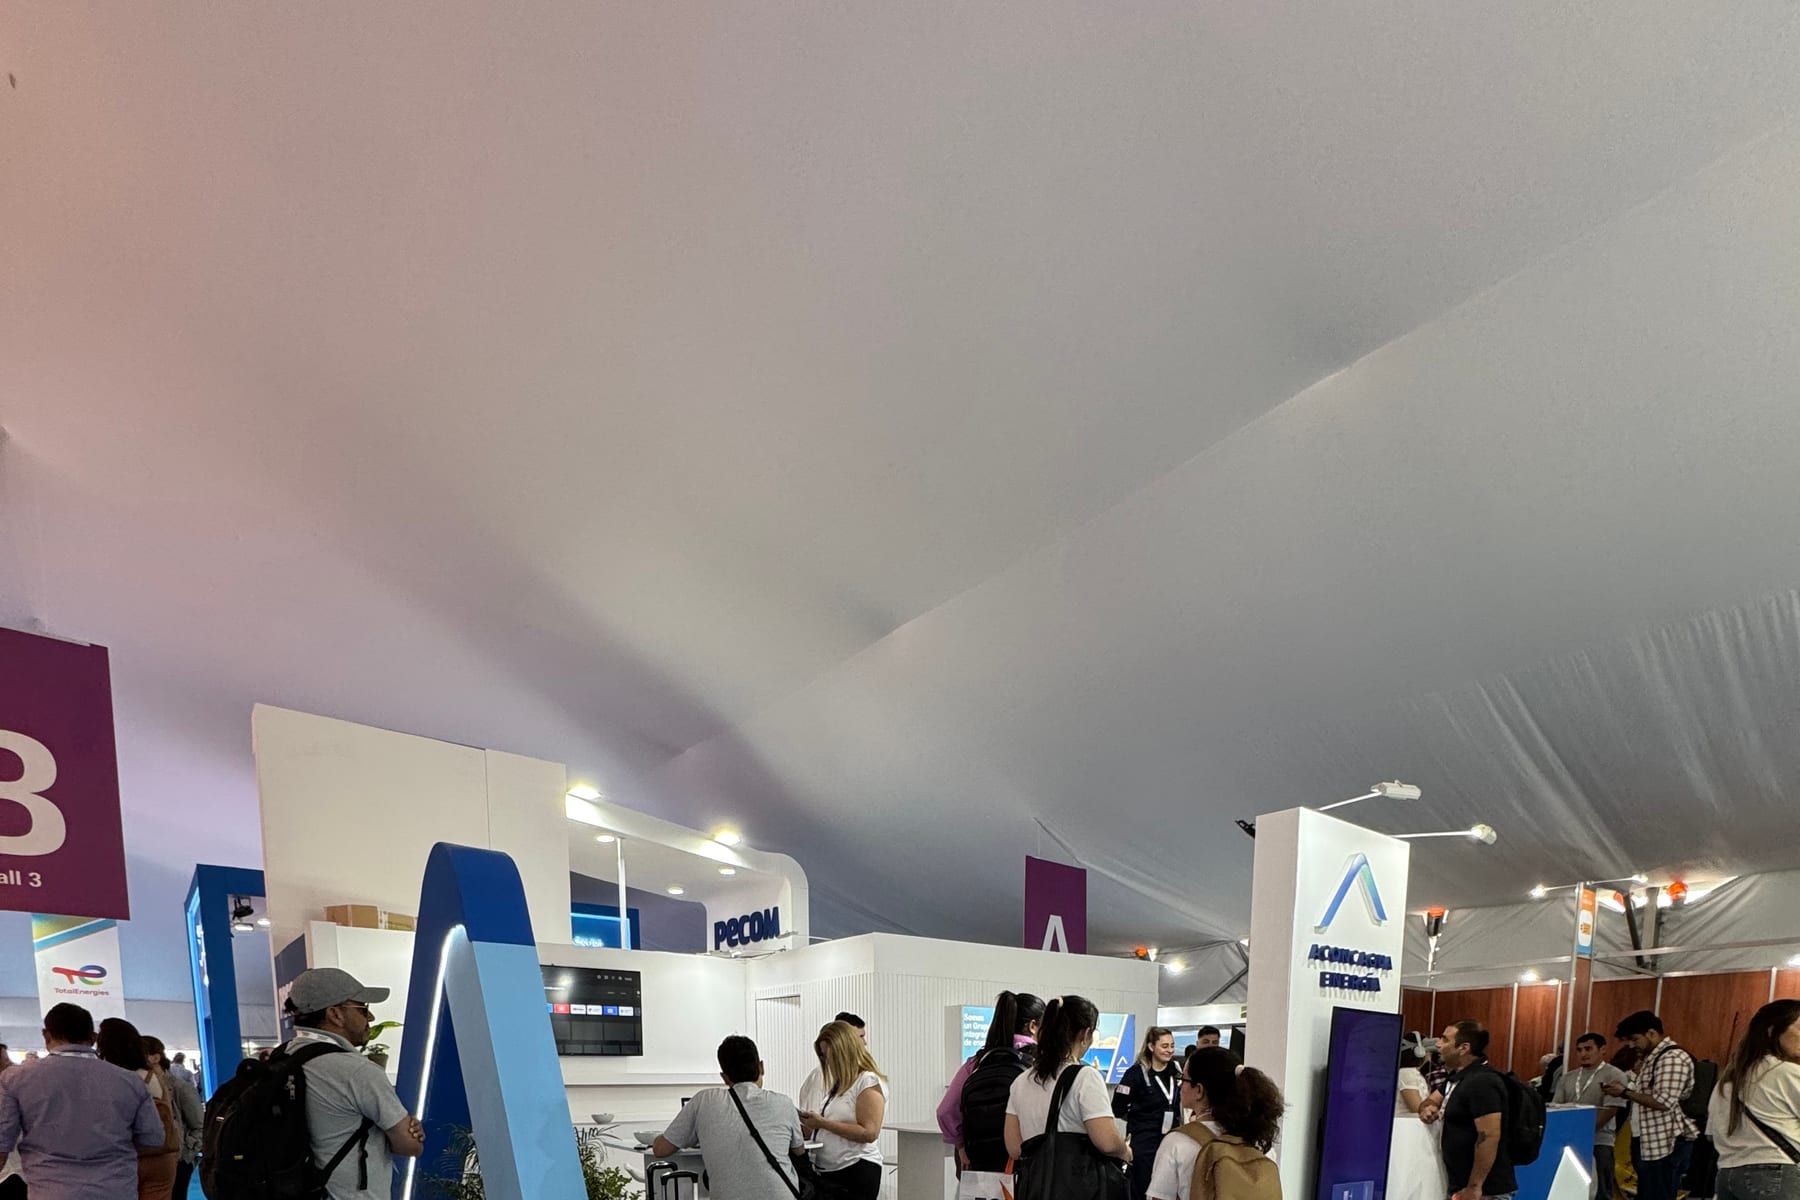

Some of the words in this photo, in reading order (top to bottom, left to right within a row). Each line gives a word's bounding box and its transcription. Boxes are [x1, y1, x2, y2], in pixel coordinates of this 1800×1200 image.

[0, 729, 66, 856] B
[0, 869, 21, 885] all
[28, 872, 42, 887] 3
[1042, 914, 1069, 953] A
[1308, 944, 1392, 970] ACONCAGUA
[55, 988, 109, 996] TotalEnergies
[1319, 972, 1381, 992] ENERGÍA
